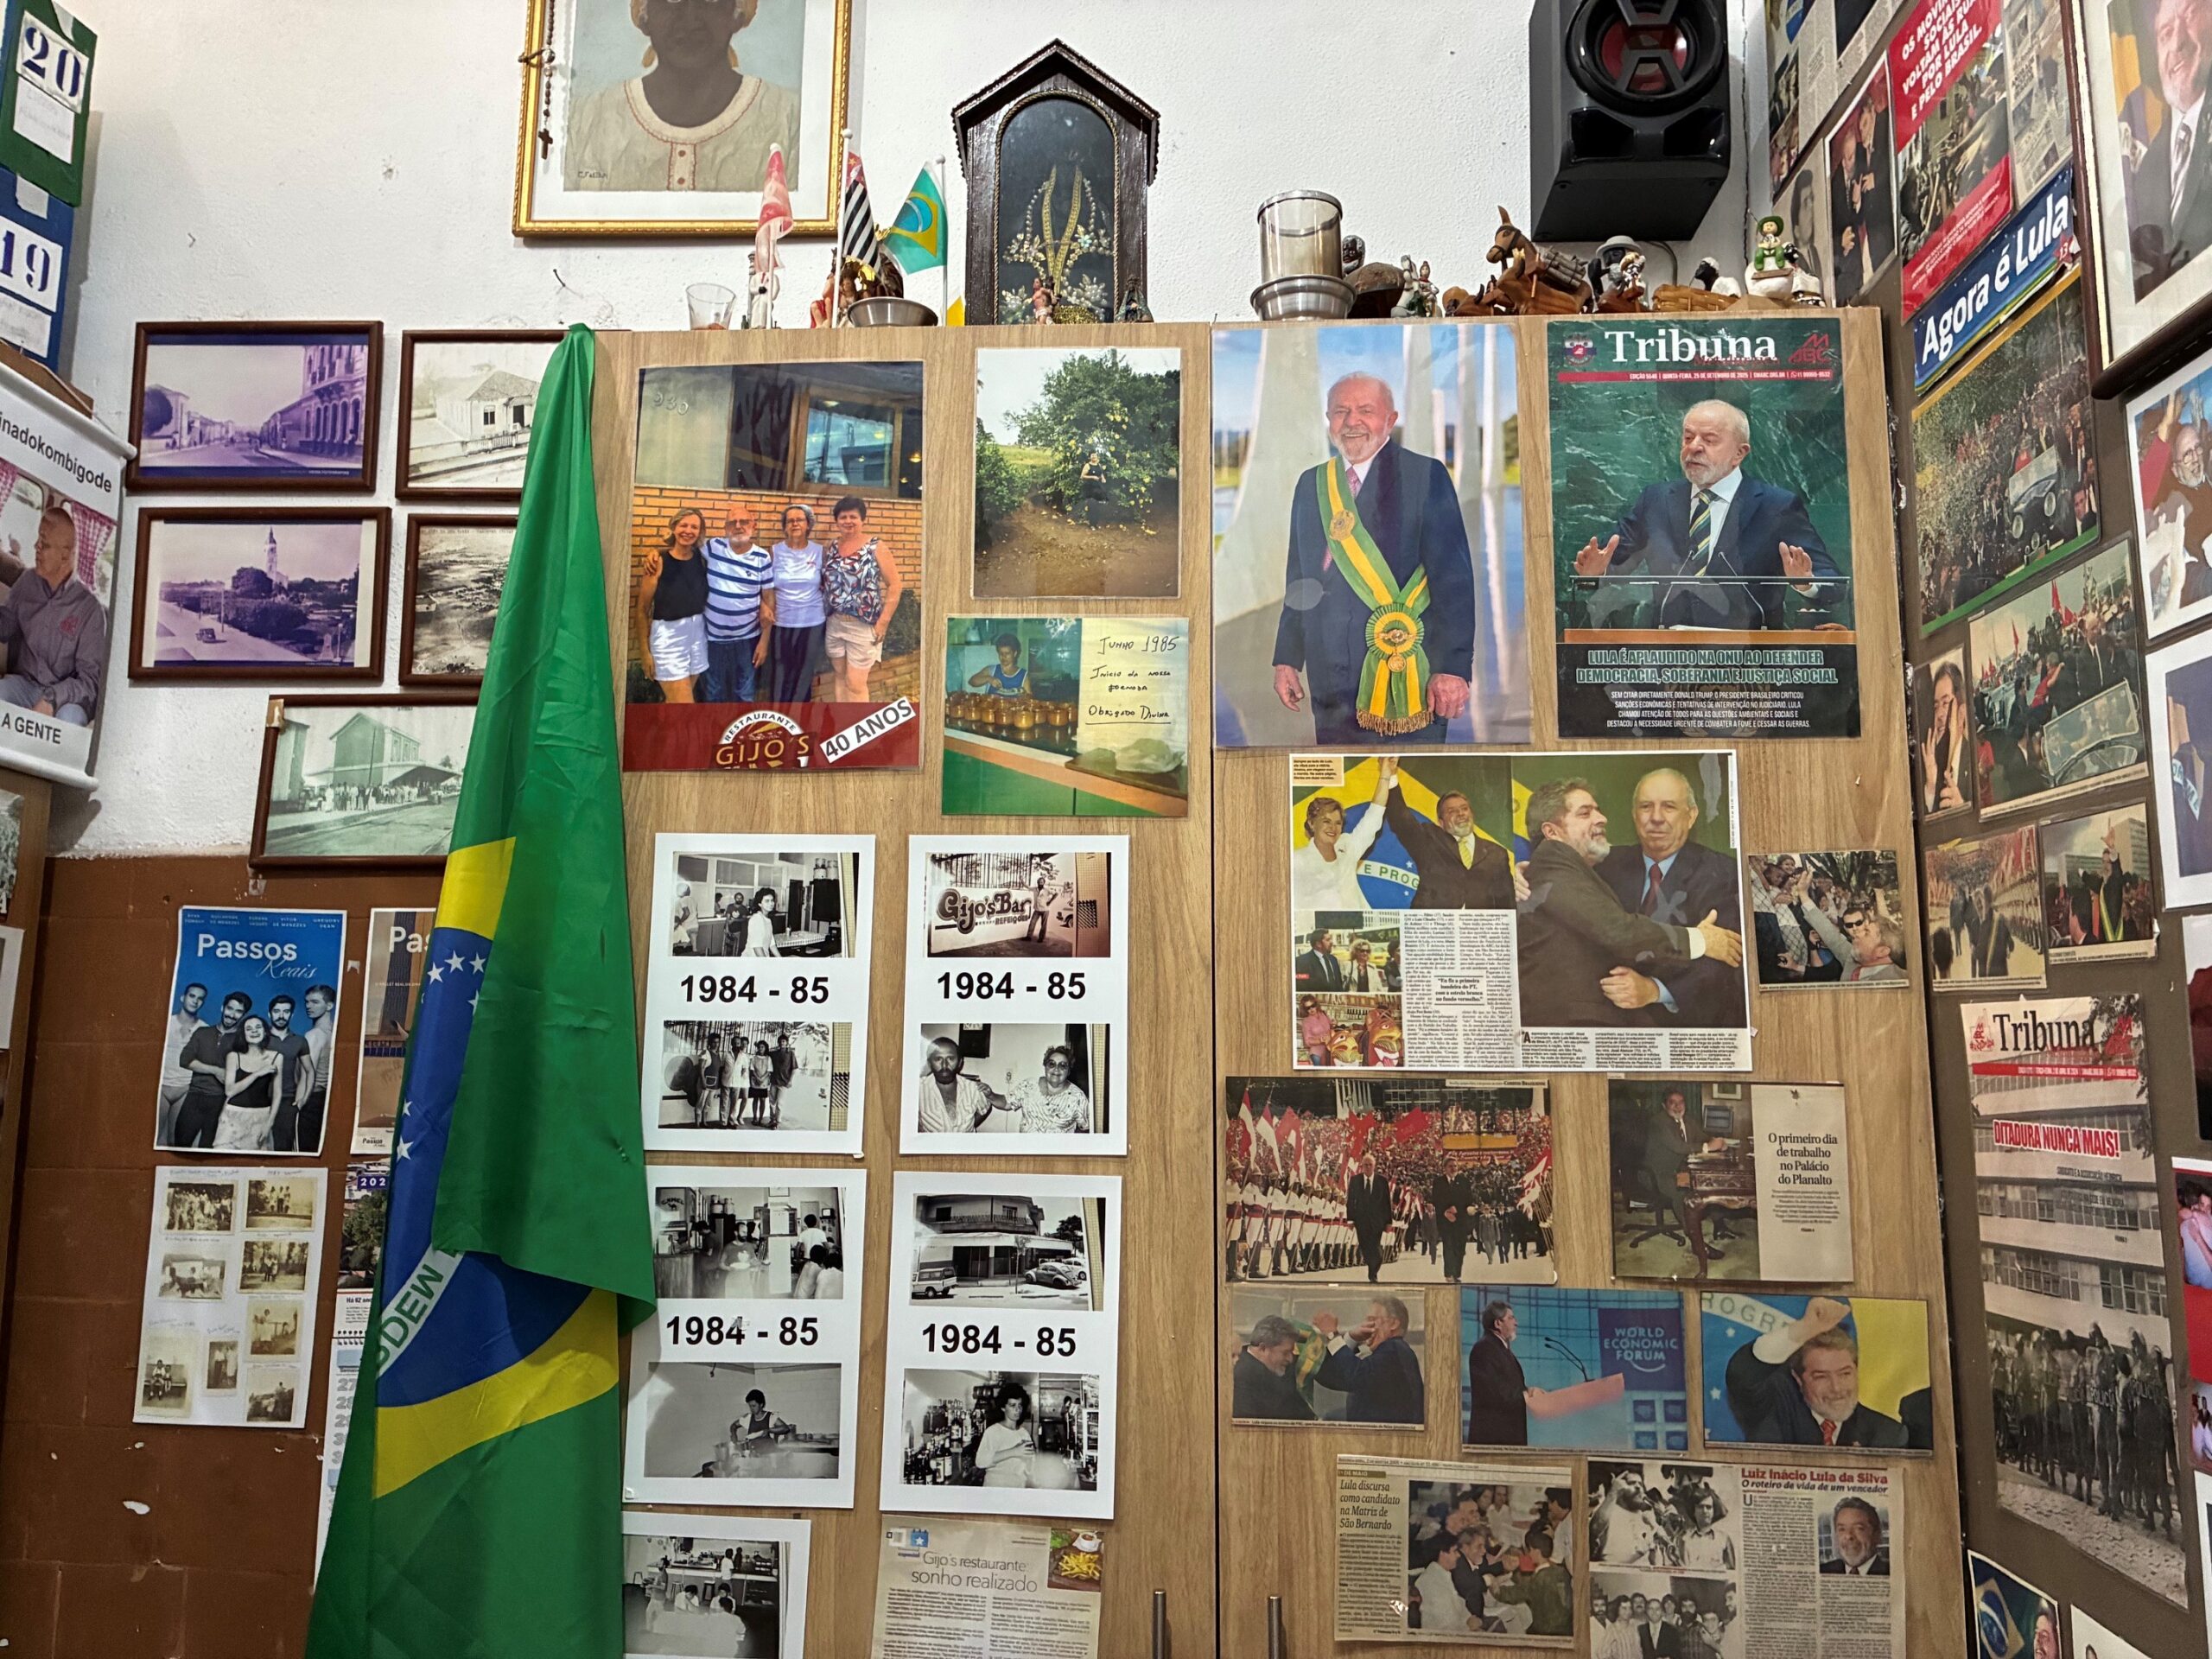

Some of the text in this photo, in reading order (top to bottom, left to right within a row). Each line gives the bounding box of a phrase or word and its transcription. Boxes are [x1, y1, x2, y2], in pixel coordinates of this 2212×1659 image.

[1902, 35, 1915, 60] OS
[1922, 19, 1969, 88] POR LULA
[22, 27, 81, 97] 20
[1903, 38, 1940, 94] VOLTAM
[1911, 103, 1918, 120] E
[1918, 74, 1942, 110] PELO
[0, 230, 49, 293] 19
[1922, 273, 1990, 365] Agora
[1994, 244, 2011, 293] é
[2016, 193, 2069, 276] Lula
[1605, 328, 1777, 363] Tribuna
[1141, 636, 1179, 652] 1985
[1588, 647, 1824, 665] LULA É APLAUDIDO NA ONU AO DEFENDER
[1576, 668, 1839, 686] DEMOCRACIA, SOBERANIA E JUSTIÇA SOCIAL
[1615, 700, 1639, 709] SANÇÕES
[1639, 700, 1672, 709] ECONÔMICAS
[1715, 700, 1750, 709] INTERVENÇÃO
[1641, 709, 1664, 719] ATENÇÃO
[2, 710, 61, 745] A GENTE
[725, 712, 797, 741] RESTAURANTE
[825, 700, 912, 759] 40 ANOS
[995, 892, 1032, 918] Bar
[197, 933, 297, 962] Passos
[681, 975, 757, 1003] 1984
[790, 976, 830, 1004] 85
[937, 972, 1014, 999] 1984
[1047, 972, 1086, 1000] 85
[1993, 1010, 2095, 1052] Tribuna
[1768, 1132, 1838, 1145] O primeiro dia
[1993, 1120, 2120, 1160] DITADURA NUNCA MAIS!
[1777, 1147, 1831, 1158] de trabalho
[1780, 1160, 1829, 1172] no Palácio
[1777, 1173, 1833, 1185] do Planalto
[666, 1316, 746, 1345] 1984
[779, 1317, 819, 1346] 85
[922, 1323, 1002, 1354] 1984
[1036, 1327, 1076, 1357] 85
[1614, 1327, 1665, 1338] WORLD
[1604, 1338, 1679, 1350] ECONOMIC
[1616, 1350, 1666, 1361] FORUM
[1340, 1479, 1390, 1492] Lula discursa
[1741, 1468, 1888, 1484] Luiz Inácio Lula da Silva
[1741, 1479, 1750, 1488] O
[1751, 1480, 1782, 1490] roteiro
[1783, 1480, 1795, 1490] de
[1796, 1482, 1816, 1491] vida
[1817, 1482, 1828, 1491] de
[1847, 1484, 1888, 1493] vencedor
[1351, 1505, 1377, 1516] Matriz
[1378, 1507, 1389, 1517] de
[1361, 1493, 1401, 1505] candidato
[1339, 1518, 1392, 1530] São Bernardo
[912, 1568, 1037, 1592] sonho realizado
